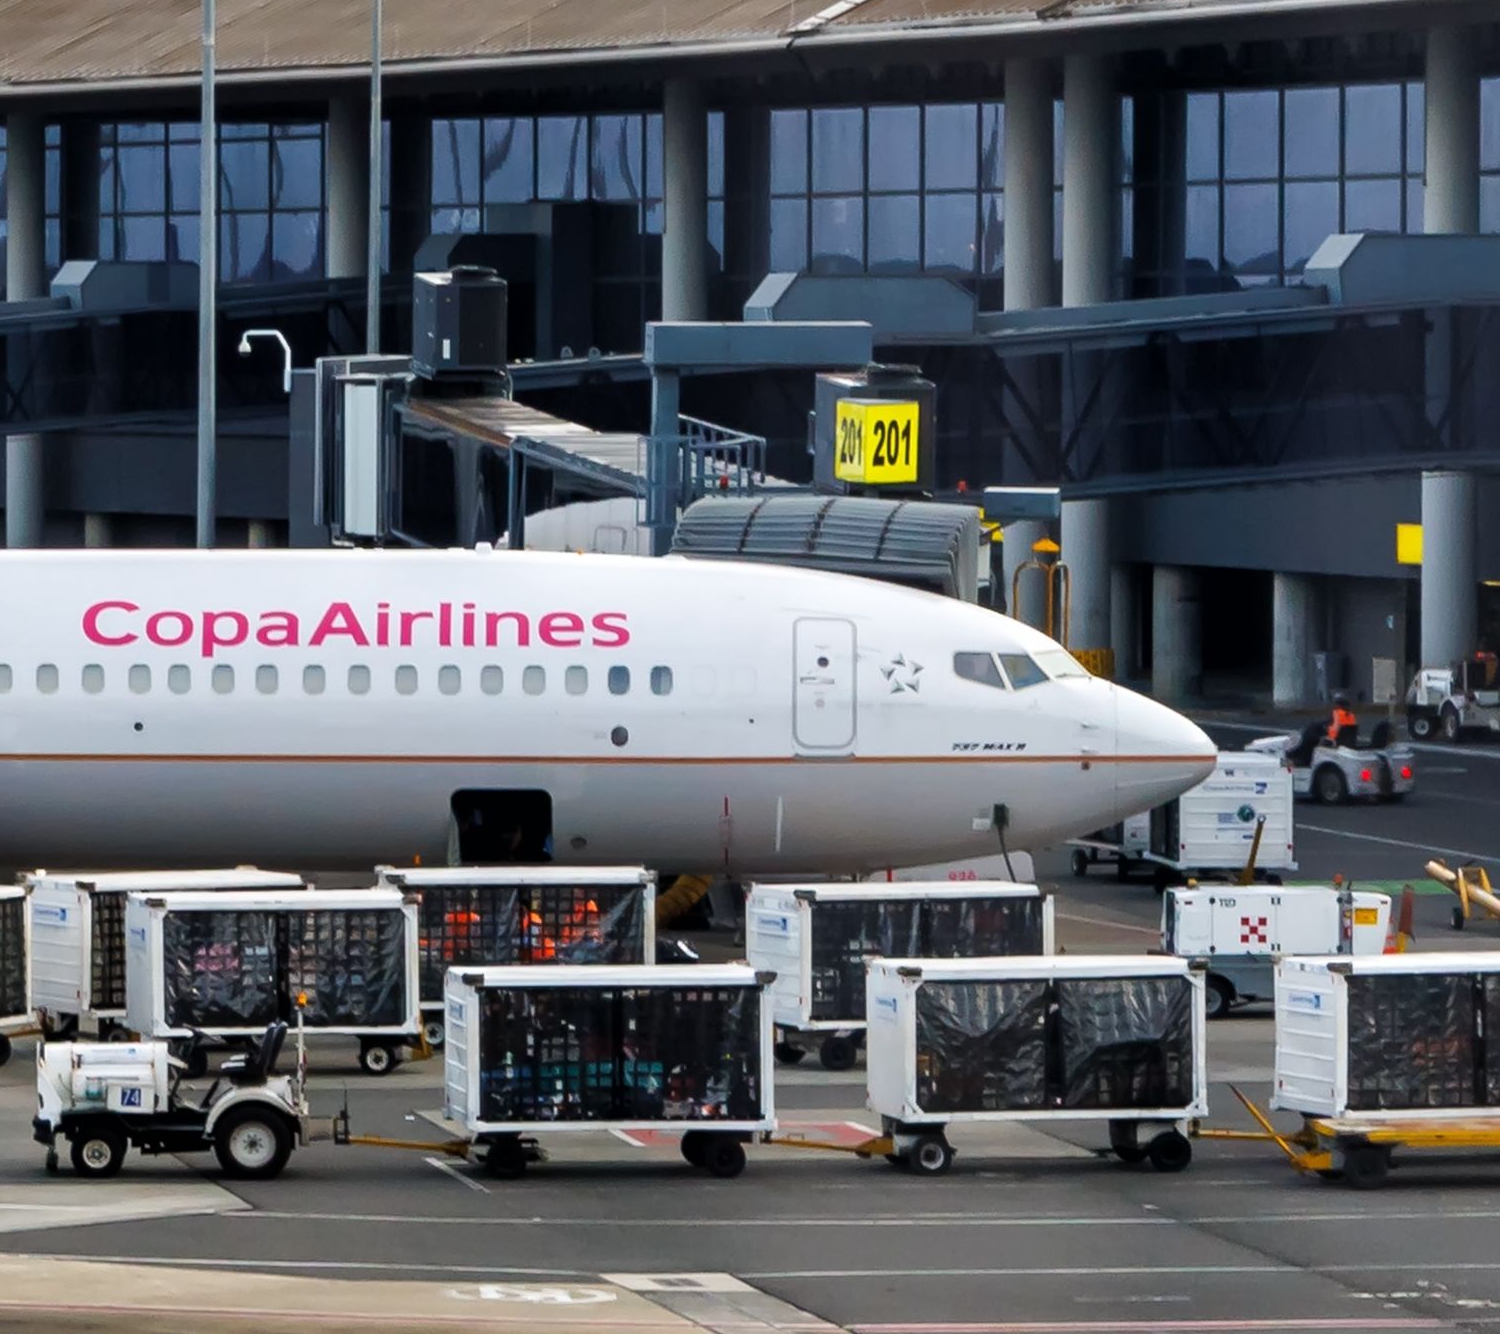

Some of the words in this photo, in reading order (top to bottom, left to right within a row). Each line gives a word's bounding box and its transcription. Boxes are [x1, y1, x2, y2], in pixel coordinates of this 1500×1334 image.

[840, 417, 862, 466] 201
[872, 419, 911, 467] 201
[81, 600, 631, 658] CopaAirlines
